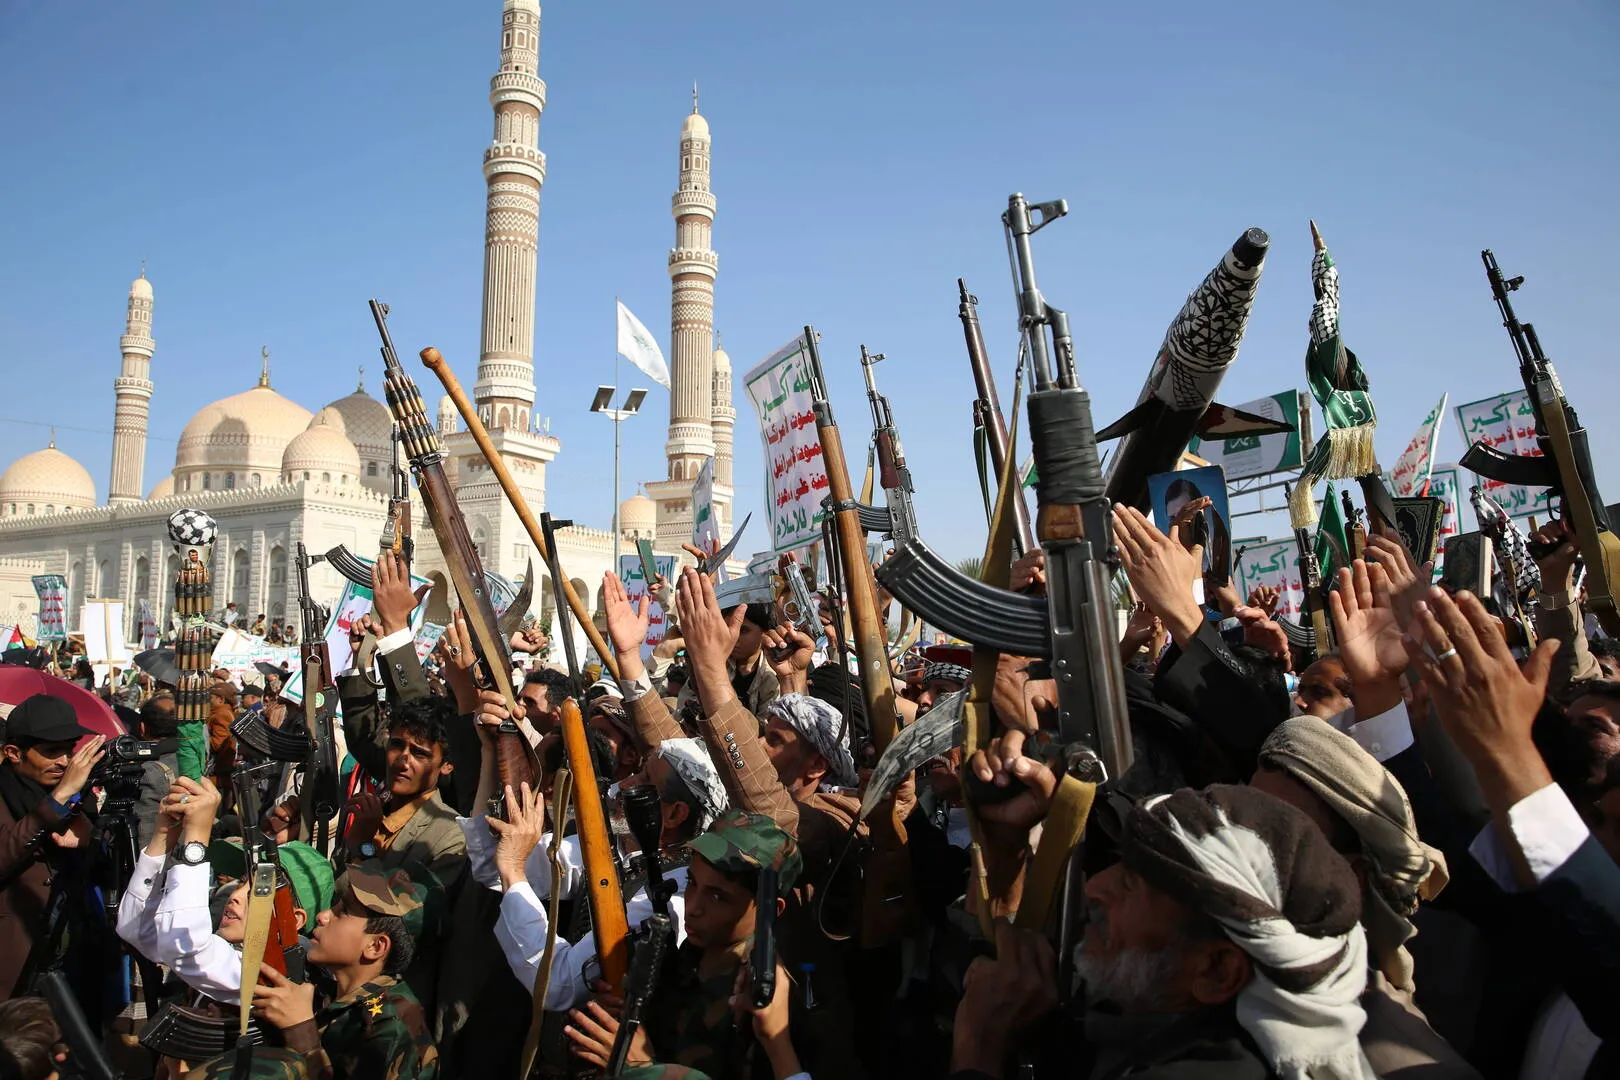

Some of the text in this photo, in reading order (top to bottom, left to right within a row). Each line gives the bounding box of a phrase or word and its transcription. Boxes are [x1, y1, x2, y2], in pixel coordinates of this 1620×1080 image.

[790, 409, 817, 431] موت
[1468, 398, 1512, 434] أكبر
[796, 442, 823, 464] موت
[1246, 546, 1289, 581] أكبر
